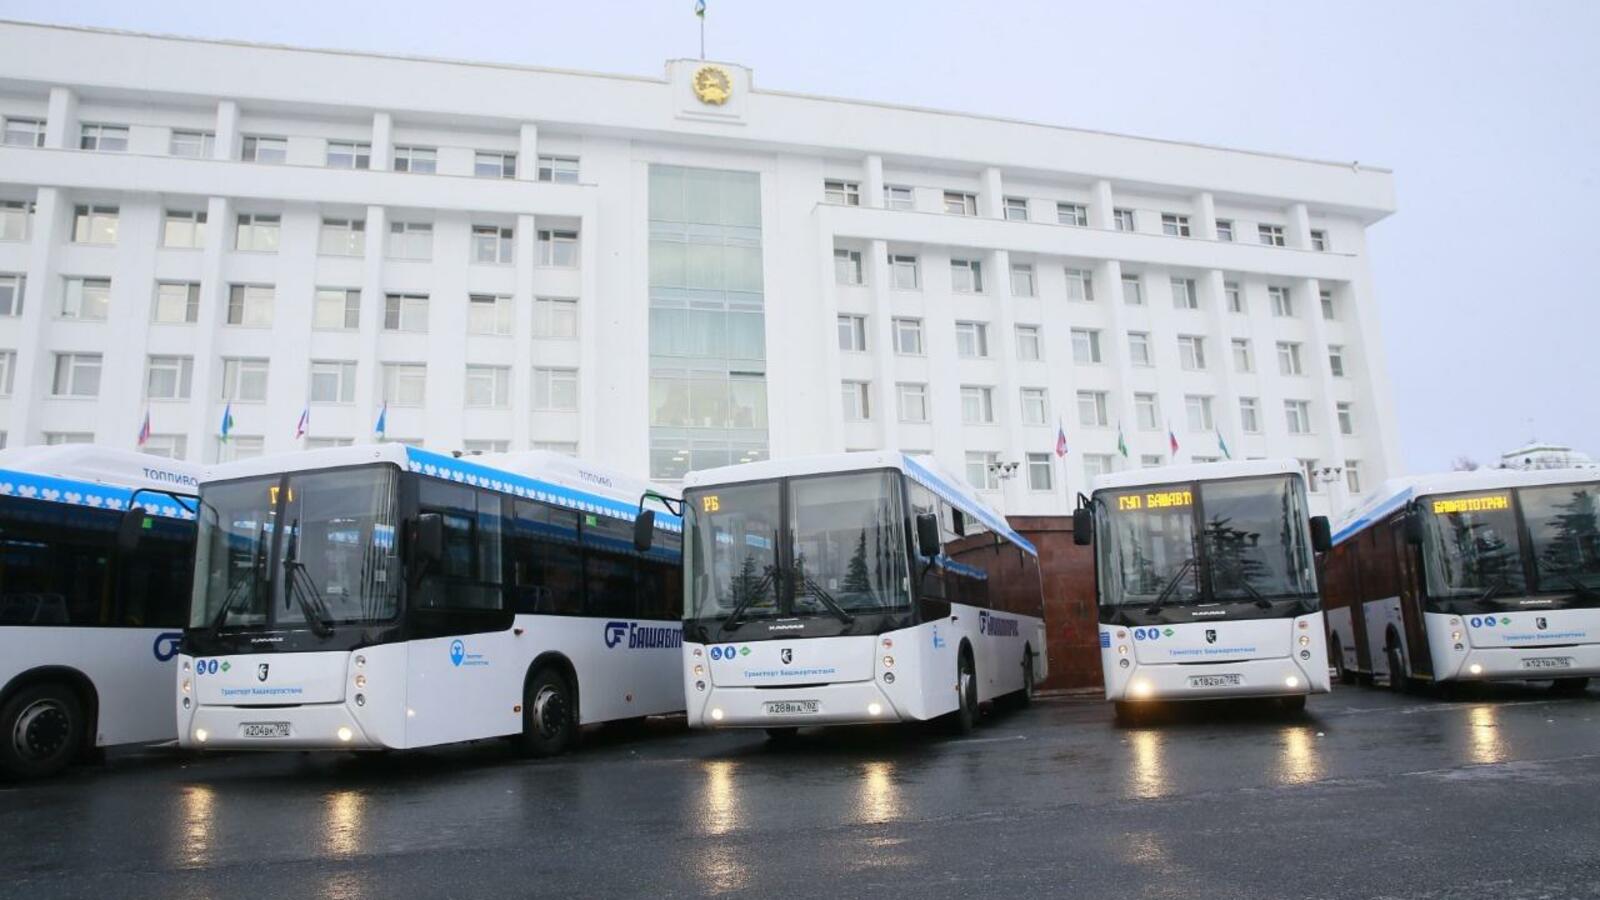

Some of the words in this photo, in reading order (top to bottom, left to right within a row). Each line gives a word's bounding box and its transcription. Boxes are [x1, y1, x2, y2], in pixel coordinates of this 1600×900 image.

[703, 495, 719, 512] РБ
[1119, 495, 1141, 510] ГУП
[1147, 491, 1192, 508] БАШАВТ
